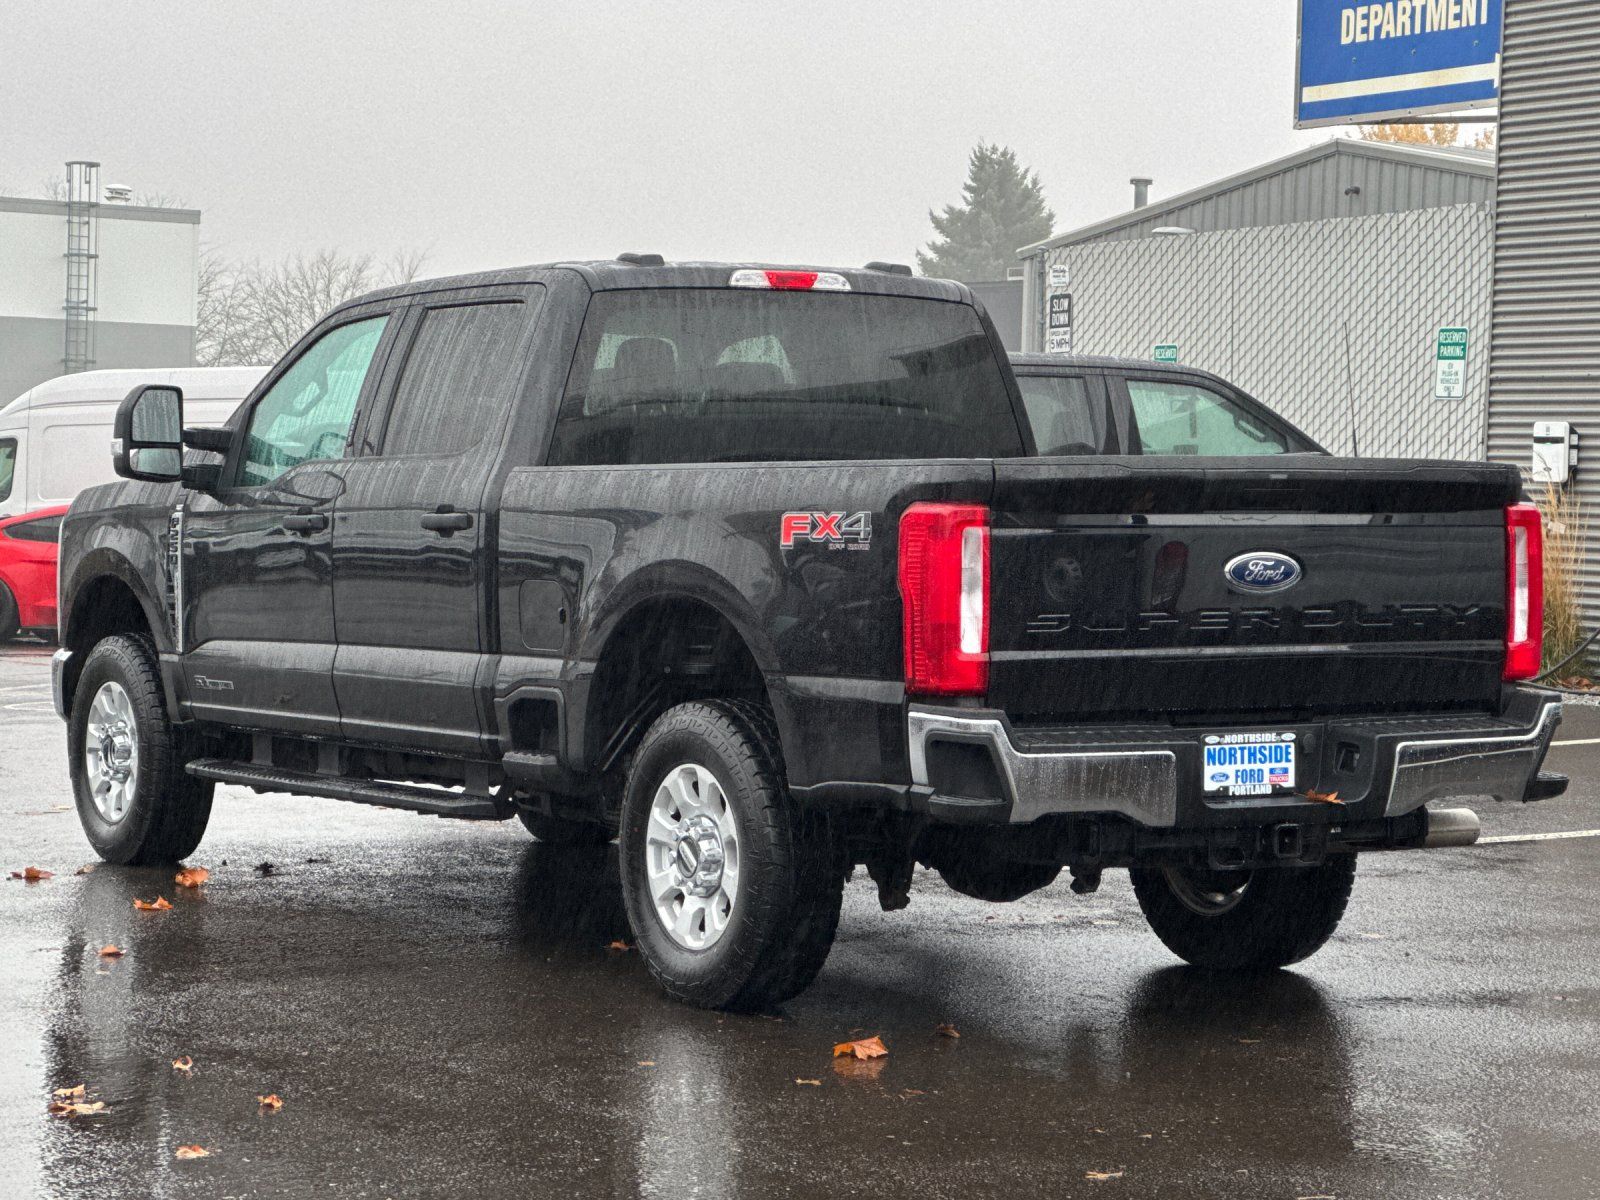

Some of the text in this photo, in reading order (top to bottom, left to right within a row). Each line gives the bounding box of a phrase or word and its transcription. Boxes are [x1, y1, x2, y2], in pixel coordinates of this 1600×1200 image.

[1341, 0, 1488, 45] DEPARTMENT
[1053, 298, 1069, 311] SLOW
[1051, 313, 1069, 326] DOWN
[1051, 338, 1070, 349] 5 MPH
[1440, 331, 1467, 343] RESERVED
[1155, 349, 1176, 358] RESERVED
[1440, 345, 1464, 357] PARKING
[780, 511, 872, 549] FX4
[1245, 560, 1285, 581] Ford
[1026, 607, 1480, 632] SUPER DUTY
[1224, 733, 1277, 744] NORTHSIDE
[1206, 744, 1292, 766] NORTHSIDE
[1235, 769, 1264, 784] FORD
[1229, 784, 1272, 796] PORTLAND
